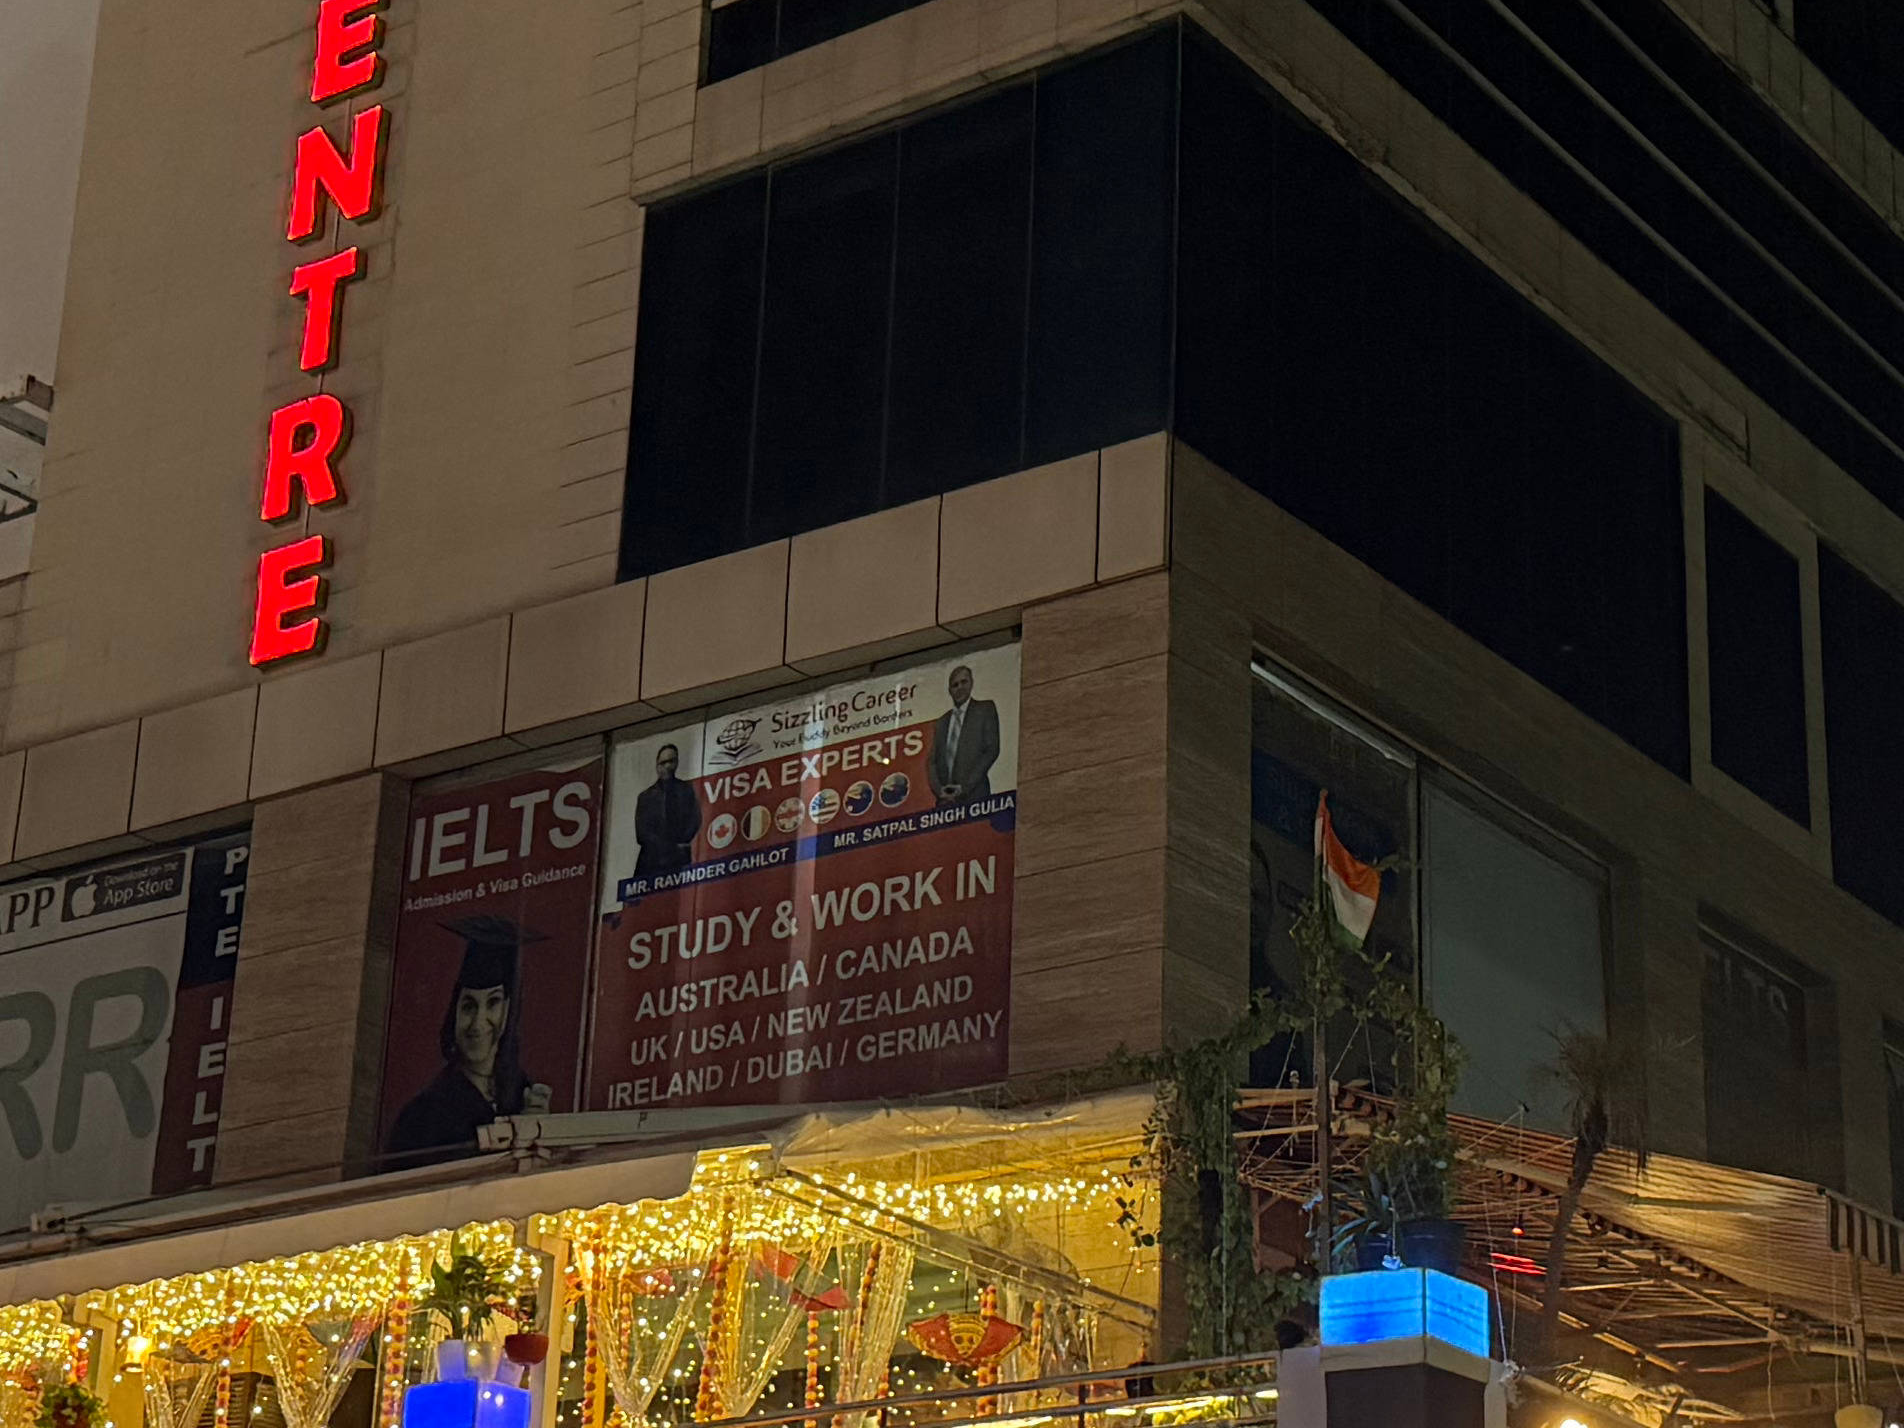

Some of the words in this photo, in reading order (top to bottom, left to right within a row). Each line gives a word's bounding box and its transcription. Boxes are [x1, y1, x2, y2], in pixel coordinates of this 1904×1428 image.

[771, 701, 849, 733] Sizzling
[852, 684, 918, 712] Career
[704, 768, 772, 805] VISA
[781, 730, 924, 787] EXPERTS
[408, 780, 592, 881] IELTS
[833, 834, 859, 848] MR.
[862, 820, 916, 842] SATPAL
[920, 805, 965, 829] SINGH
[969, 796, 1014, 817] GULIA
[104, 887, 134, 907] App
[137, 877, 174, 899] Store
[215, 846, 248, 958] PTE
[405, 887, 473, 913] Admission
[489, 875, 518, 895] Visa
[521, 863, 587, 887] Guidance
[625, 878, 651, 897] MR.
[654, 862, 725, 891] RAVINDER
[728, 847, 789, 873] GAHLOT
[628, 906, 762, 972] STUDY
[770, 900, 799, 940] &
[810, 866, 944, 932] WORK
[957, 855, 996, 900] IN
[634, 958, 809, 1023] AUSTRALIA
[835, 926, 974, 982] CANADA
[607, 1064, 724, 1110] IRELAND
[747, 1045, 833, 1087] DUBAI
[857, 1010, 1003, 1064] GERMANY
[630, 1031, 668, 1065] UK
[690, 1018, 746, 1056] USA
[768, 1002, 833, 1040] NEW
[837, 974, 974, 1027] ZEALAND
